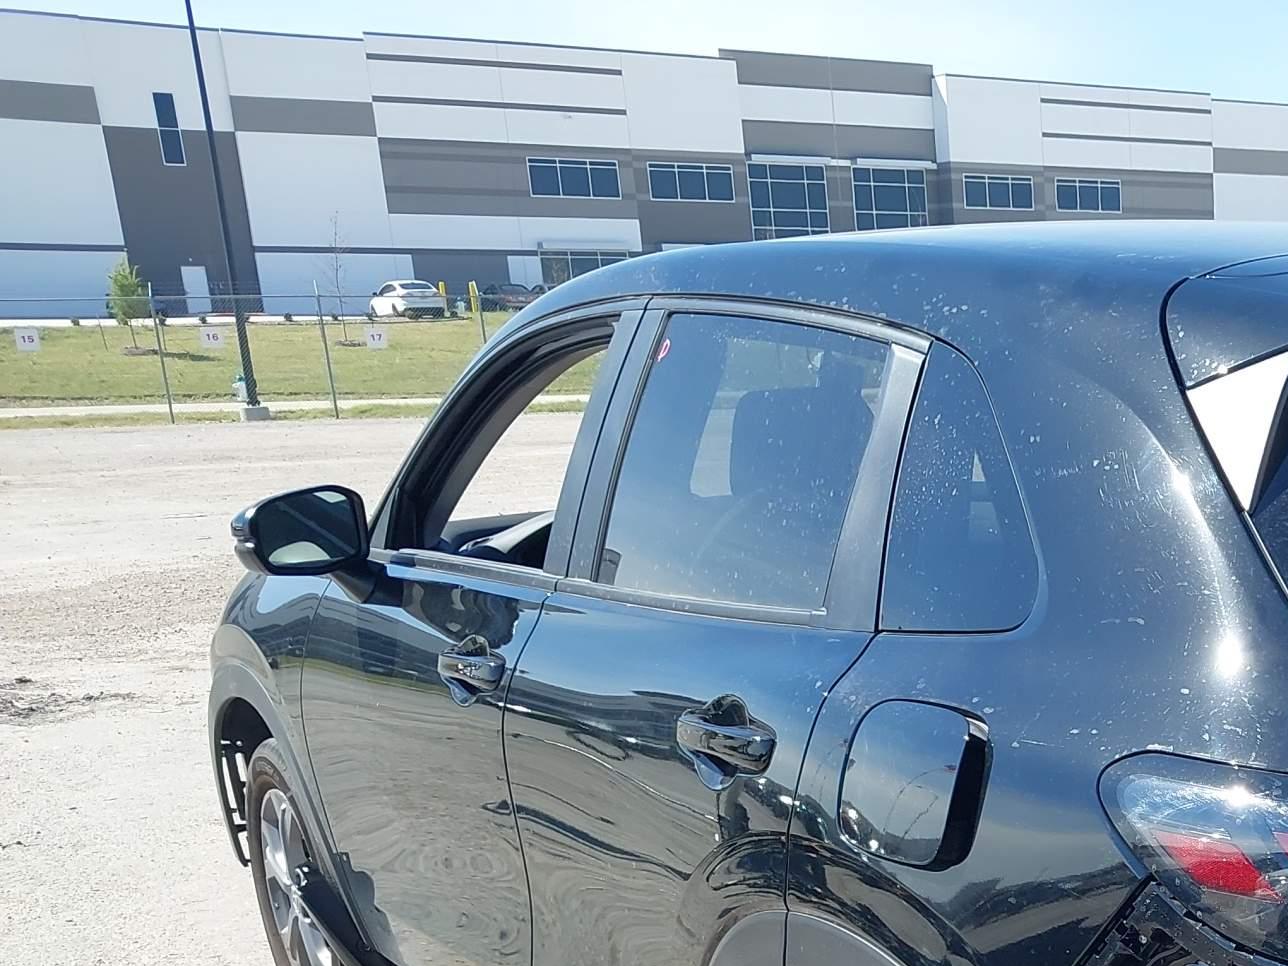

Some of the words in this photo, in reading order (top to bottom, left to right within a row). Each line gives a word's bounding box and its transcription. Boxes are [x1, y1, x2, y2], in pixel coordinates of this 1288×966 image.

[21, 335, 35, 344] 15
[206, 333, 219, 341] 16
[370, 333, 382, 342] 17
